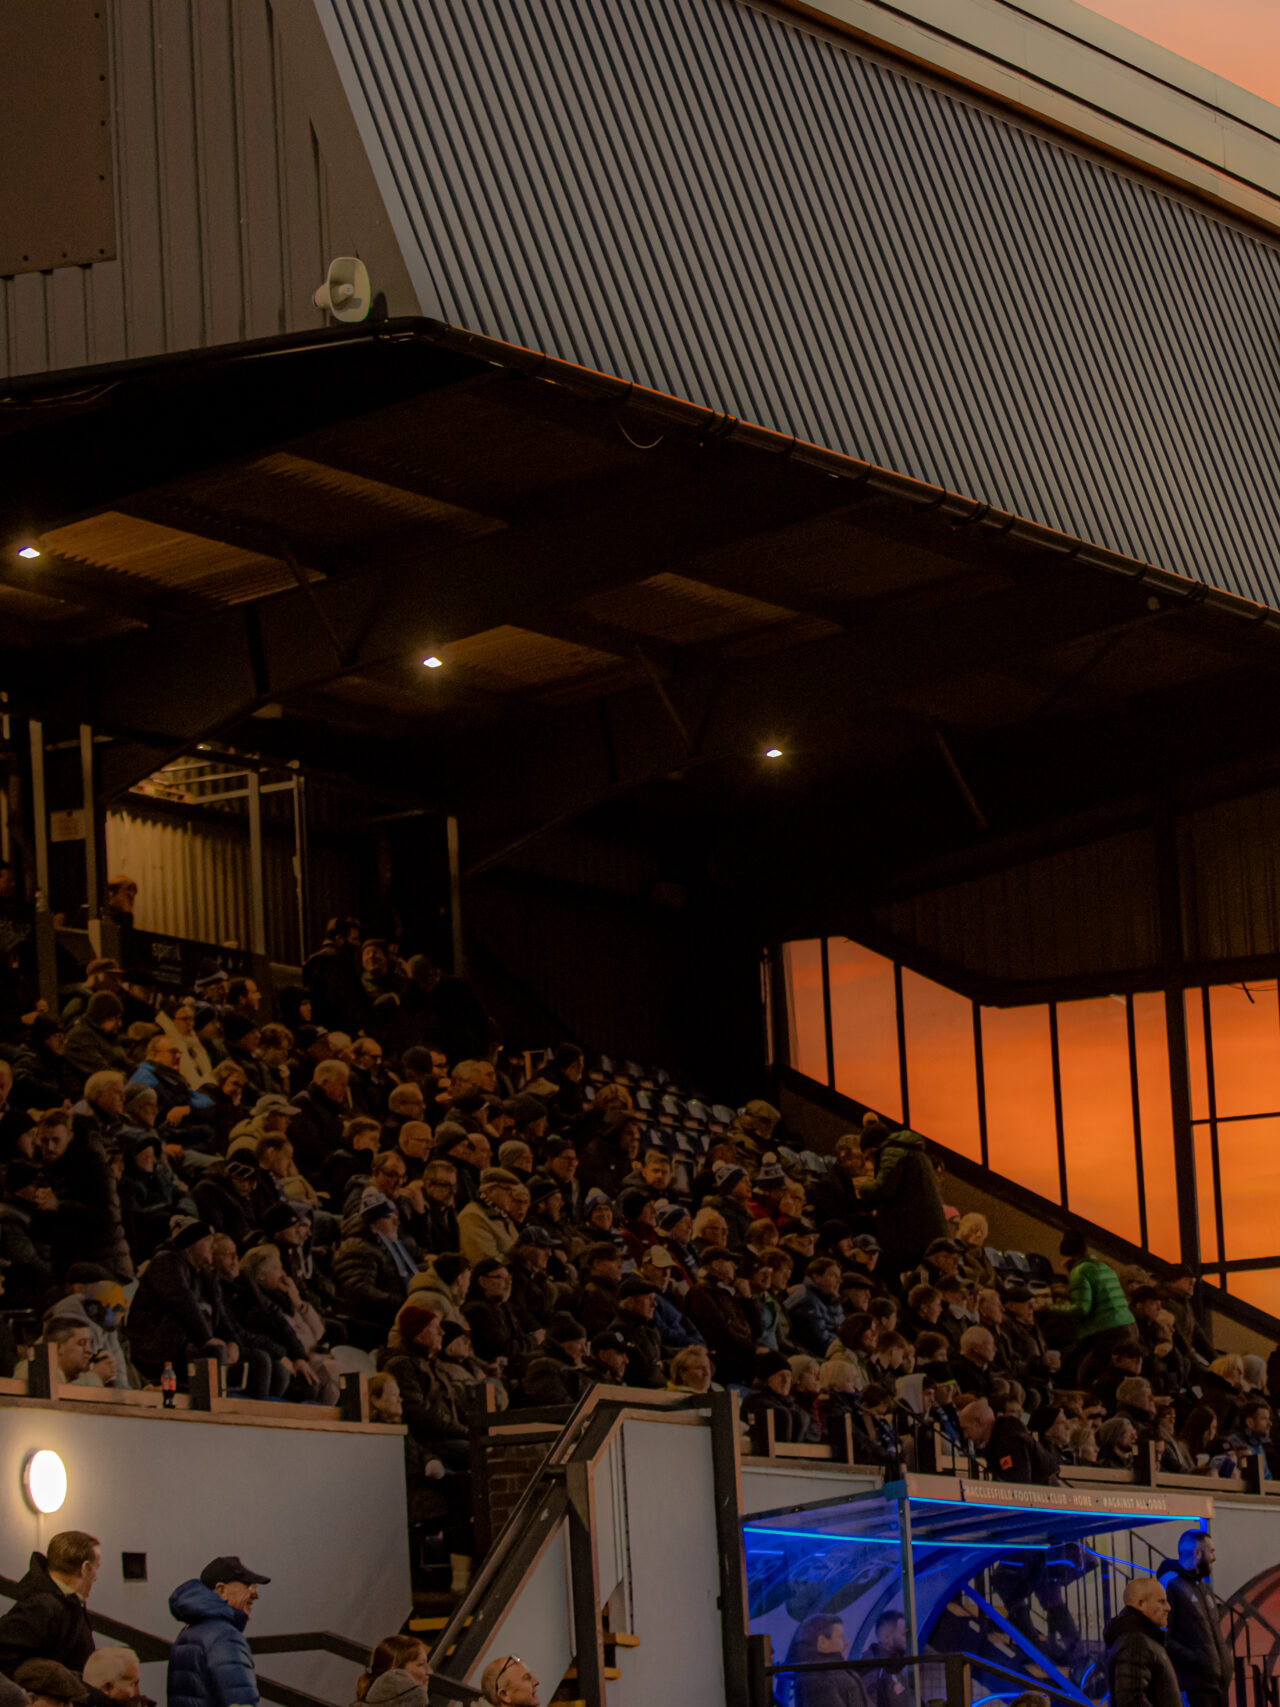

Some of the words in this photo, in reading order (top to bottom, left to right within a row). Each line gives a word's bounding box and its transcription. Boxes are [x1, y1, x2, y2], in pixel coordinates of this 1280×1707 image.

[964, 1485, 1013, 1501] MACCLESFIELD
[1014, 1490, 1049, 1503] FOOTBALL
[1050, 1493, 1068, 1504] CLUB
[1074, 1495, 1092, 1506] HOME
